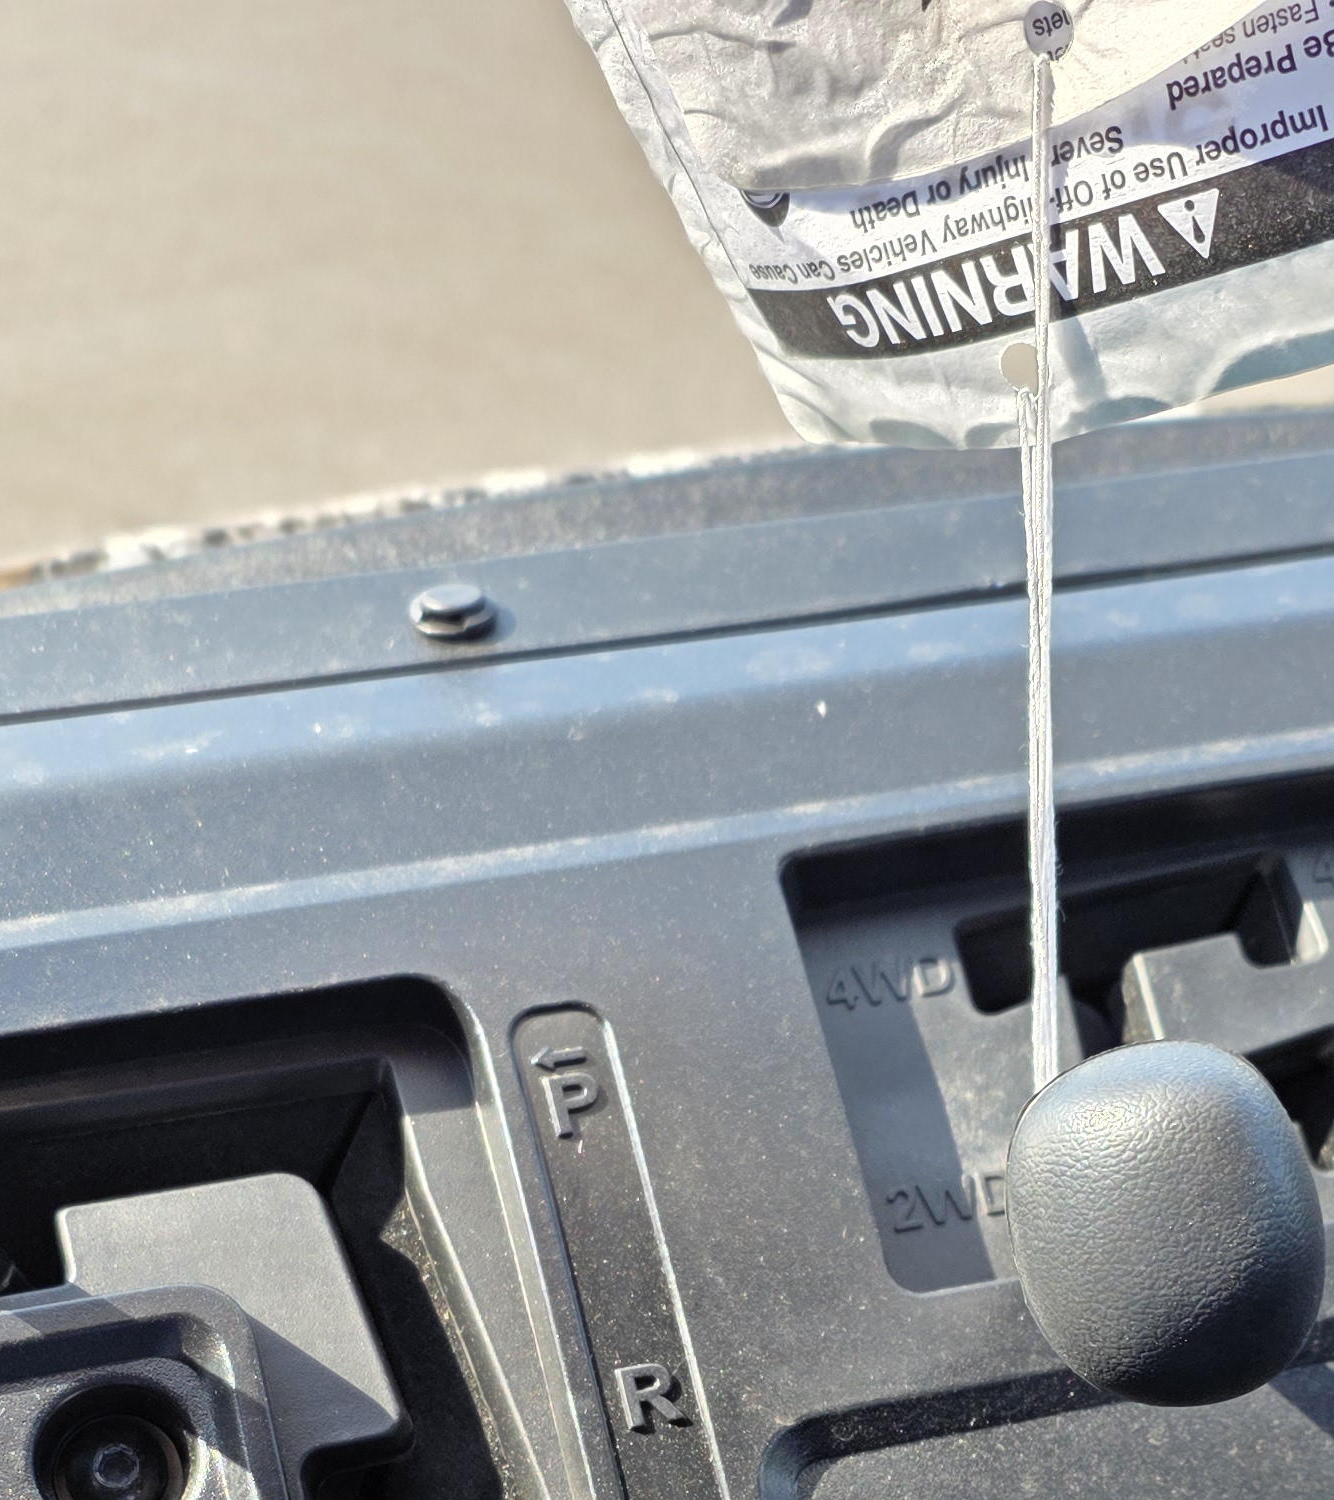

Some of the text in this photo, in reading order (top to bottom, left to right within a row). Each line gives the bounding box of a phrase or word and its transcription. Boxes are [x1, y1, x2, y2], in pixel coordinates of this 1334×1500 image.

[1240, 0, 1319, 38] Fasten
[1164, 42, 1297, 109] Prepared
[1193, 103, 1328, 166] Improper
[848, 125, 1122, 232] Sever Injury or Death
[1099, 168, 1125, 200] of
[1131, 150, 1187, 184] Use
[747, 262, 796, 285] Cause
[796, 259, 834, 283] Can
[825, 212, 1164, 347] WARNING
[835, 229, 935, 275] Vehicles
[823, 954, 957, 1014] 4WD
[542, 1072, 599, 1138] P
[615, 1363, 691, 1434] R
